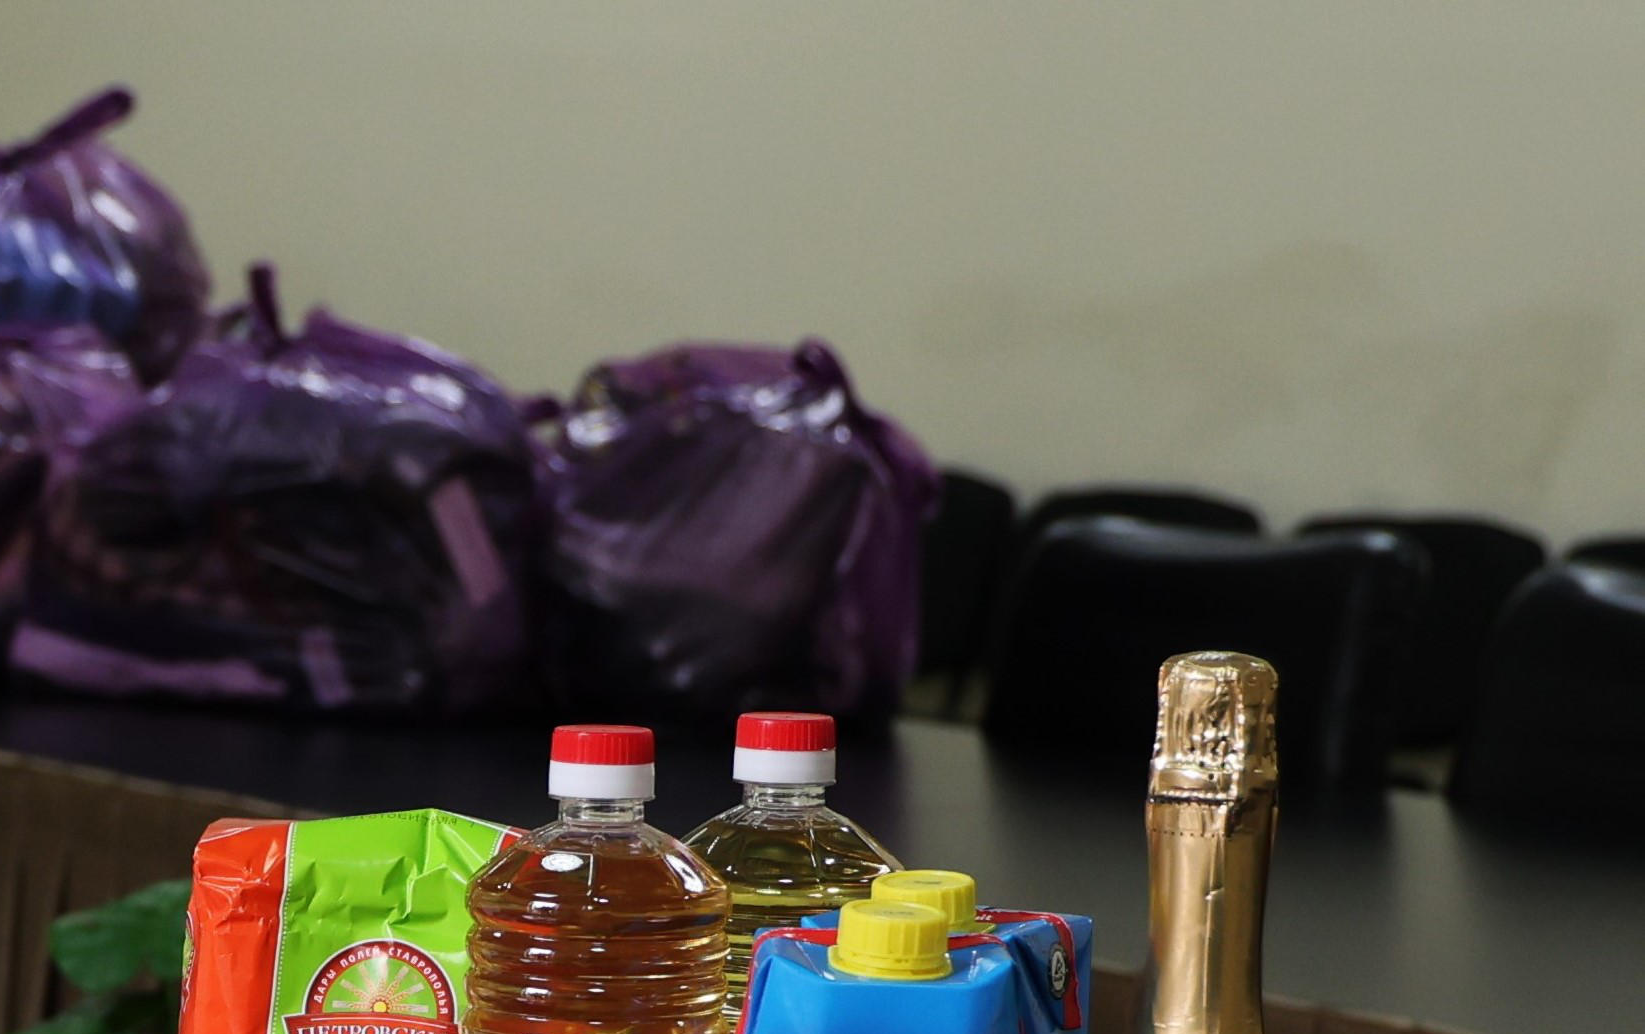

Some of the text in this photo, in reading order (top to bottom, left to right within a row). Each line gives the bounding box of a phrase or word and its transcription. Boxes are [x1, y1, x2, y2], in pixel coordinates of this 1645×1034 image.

[313, 945, 449, 1015] ДАРЫ ПОЛЕЙ СТАВРОПОЛЬЯ
